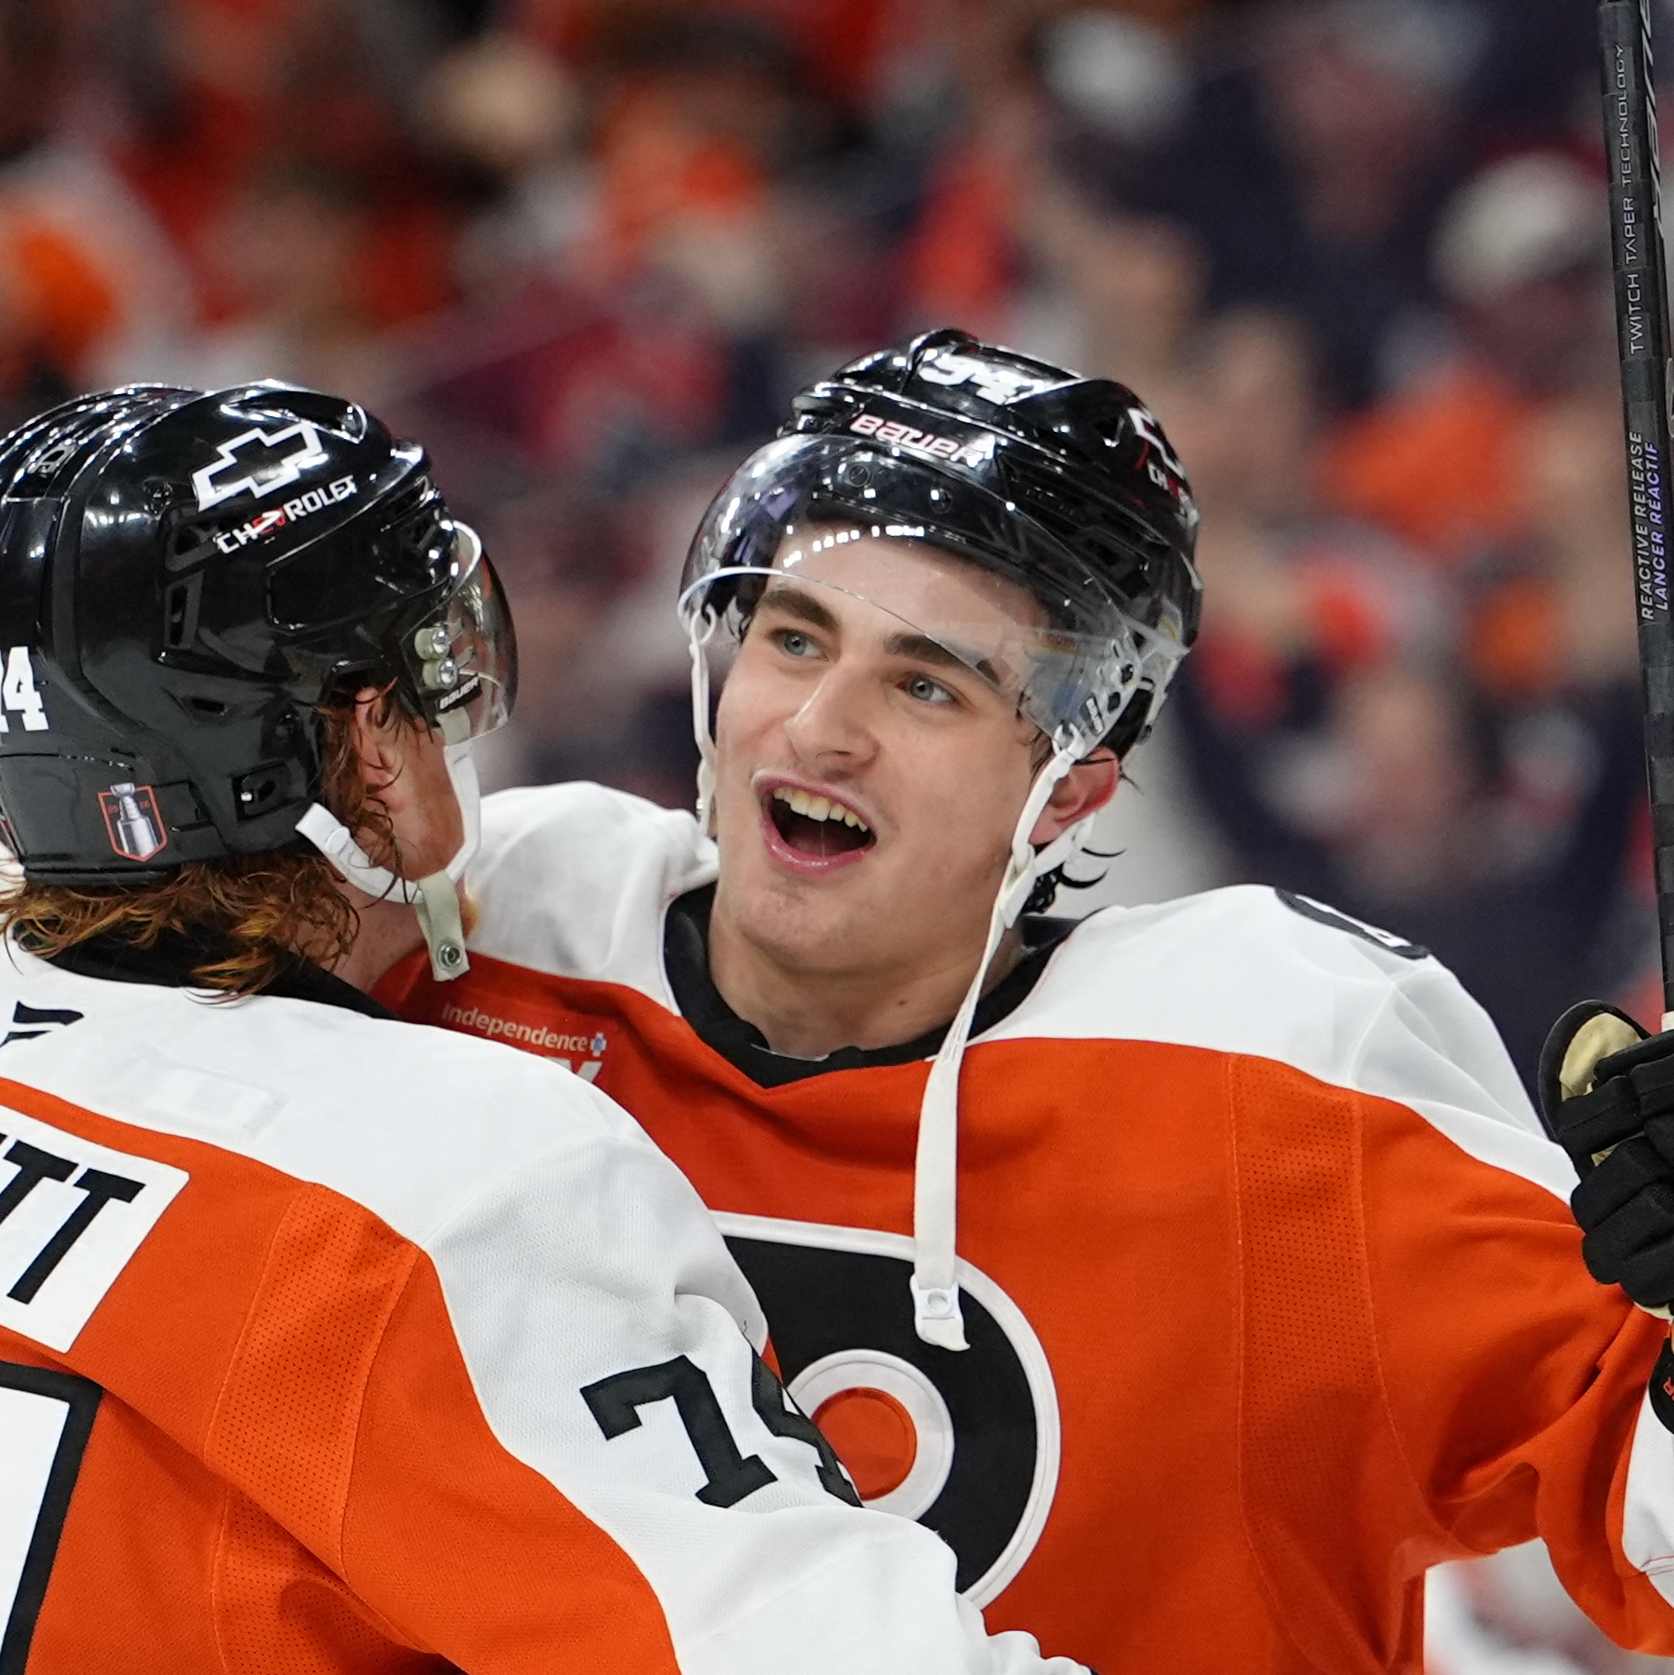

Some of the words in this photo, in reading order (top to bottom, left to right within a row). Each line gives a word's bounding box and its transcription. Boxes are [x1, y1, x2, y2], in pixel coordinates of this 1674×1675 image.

[1615, 44, 1632, 188] TECHNOLOGY
[1623, 197, 1639, 265] TAPER
[1627, 273, 1645, 355] TWITCH
[1629, 431, 1647, 518] RELEASE
[1635, 522, 1655, 621] REACTIVE
[1651, 531, 1669, 612] LANCER
[441, 1001, 588, 1052] Independence
